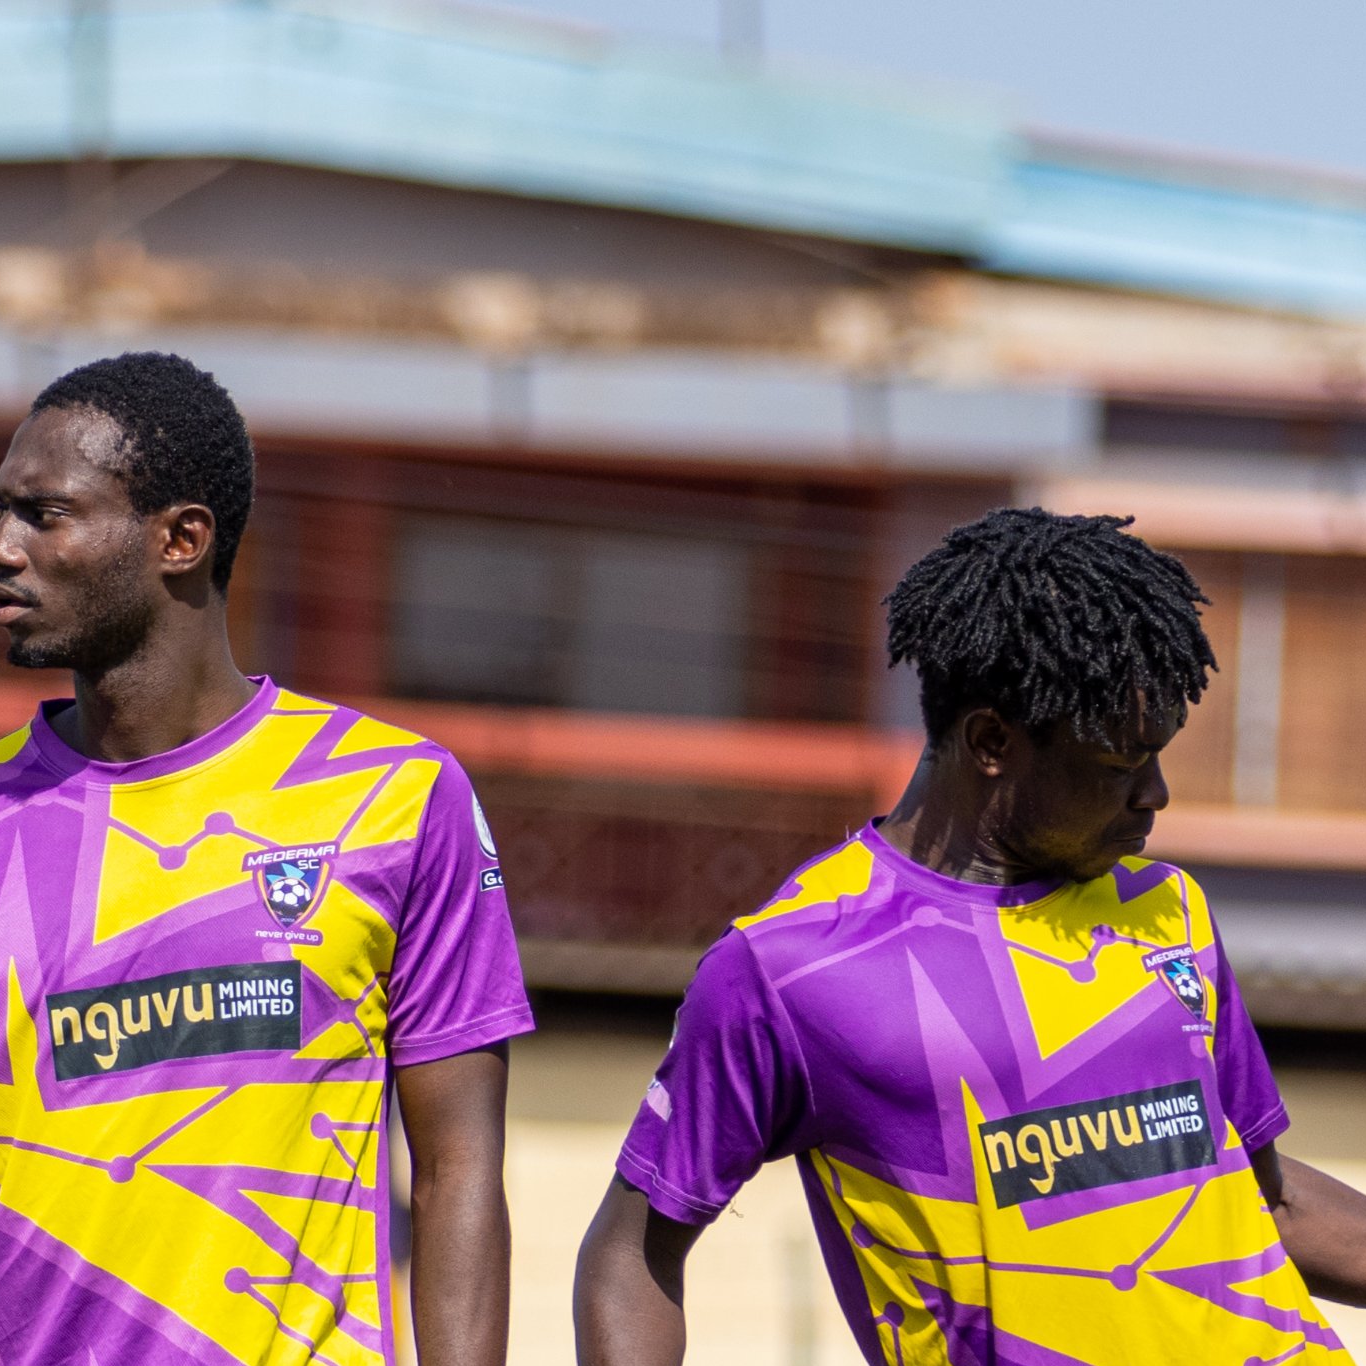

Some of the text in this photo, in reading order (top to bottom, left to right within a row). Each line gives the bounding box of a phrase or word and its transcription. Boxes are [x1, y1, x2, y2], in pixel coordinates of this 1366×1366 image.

[247, 845, 336, 867] MEDEAMA
[297, 859, 320, 870] SC
[255, 930, 319, 942] never give up
[218, 978, 294, 1000] MINING
[220, 998, 295, 1020] LIMITED
[50, 982, 215, 1070] nguvu
[1139, 1094, 1199, 1122] MINING
[1144, 1114, 1204, 1142] LIMITED
[984, 1105, 1144, 1194] nguvu
